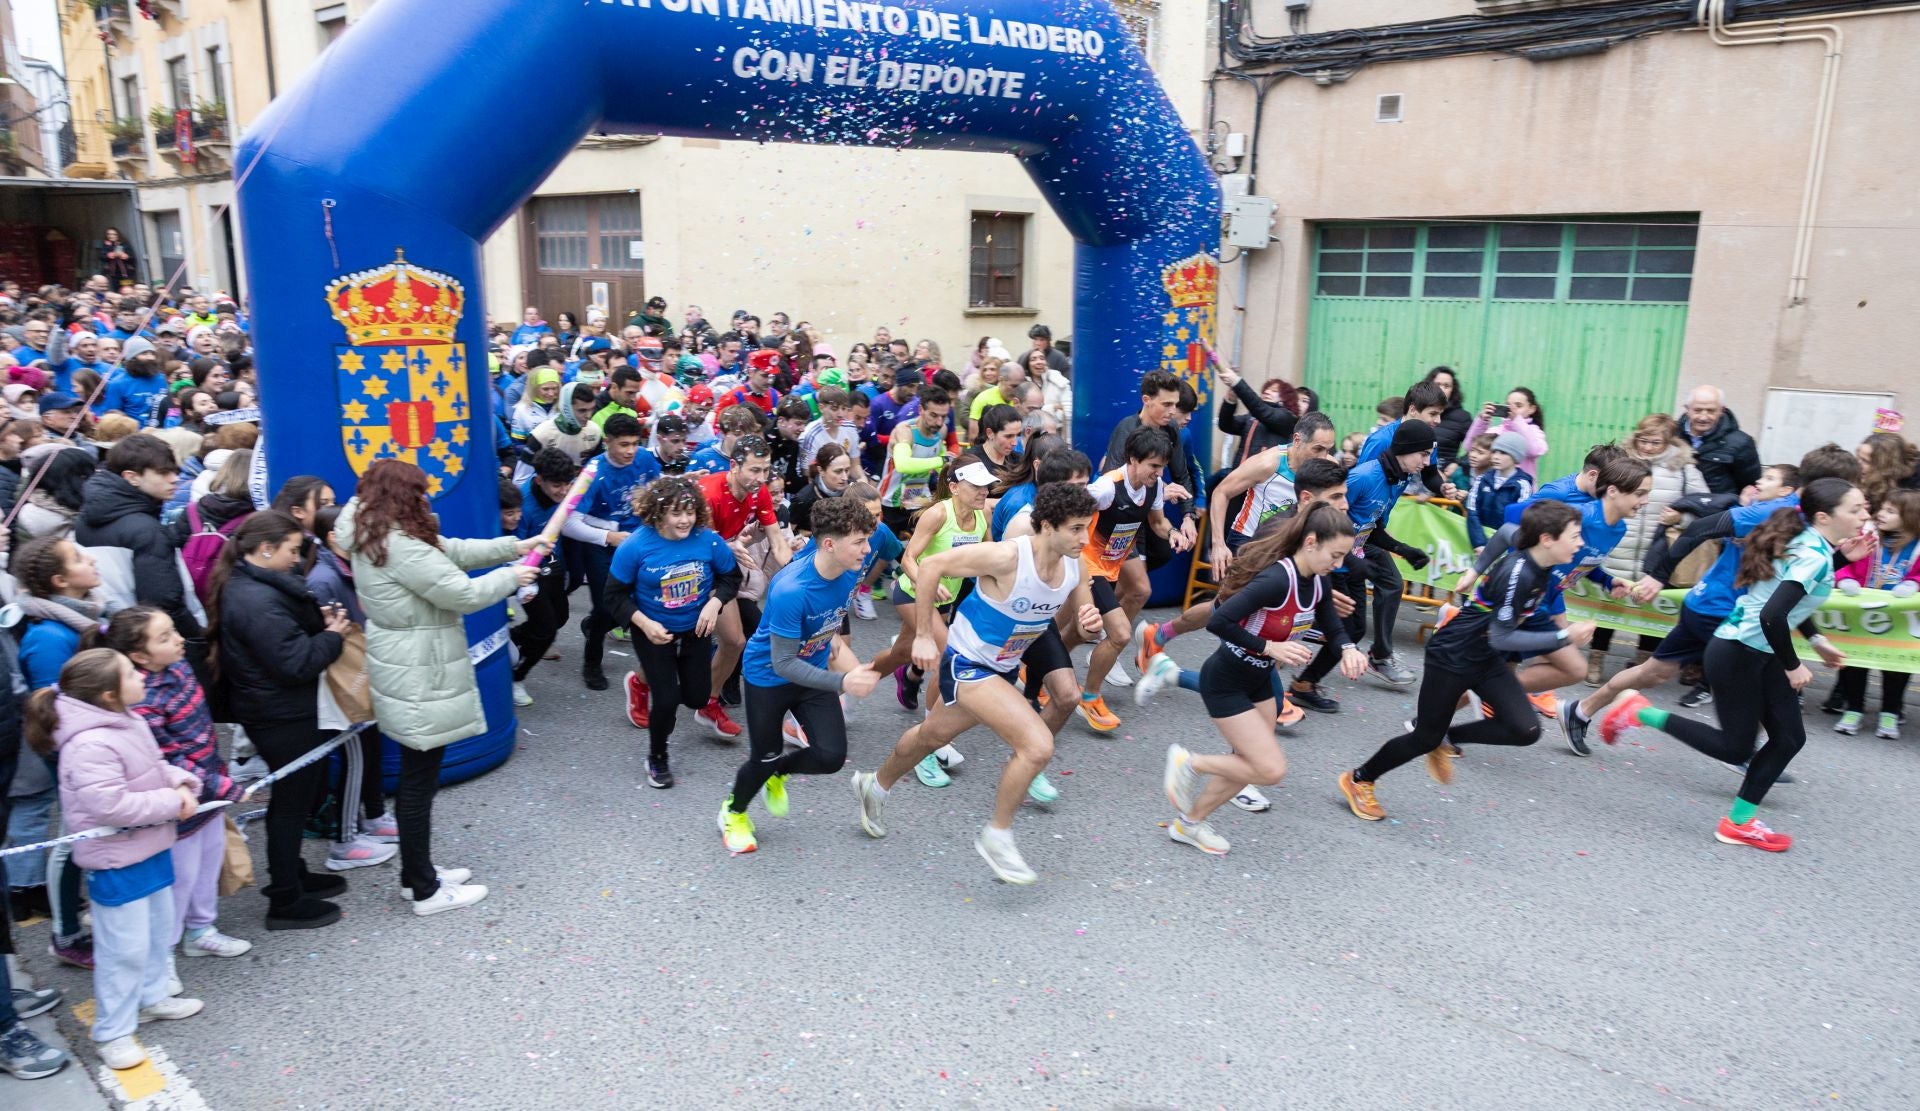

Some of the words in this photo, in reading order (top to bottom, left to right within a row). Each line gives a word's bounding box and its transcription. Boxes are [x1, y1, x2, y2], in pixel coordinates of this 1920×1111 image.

[916, 9, 962, 42] DE
[968, 15, 1104, 57] LARDERO
[732, 46, 815, 84] CON
[823, 55, 867, 88] EL
[876, 60, 1026, 99] DEPORTE
[669, 581, 691, 599] 1127
[1243, 656, 1270, 669] PRO
